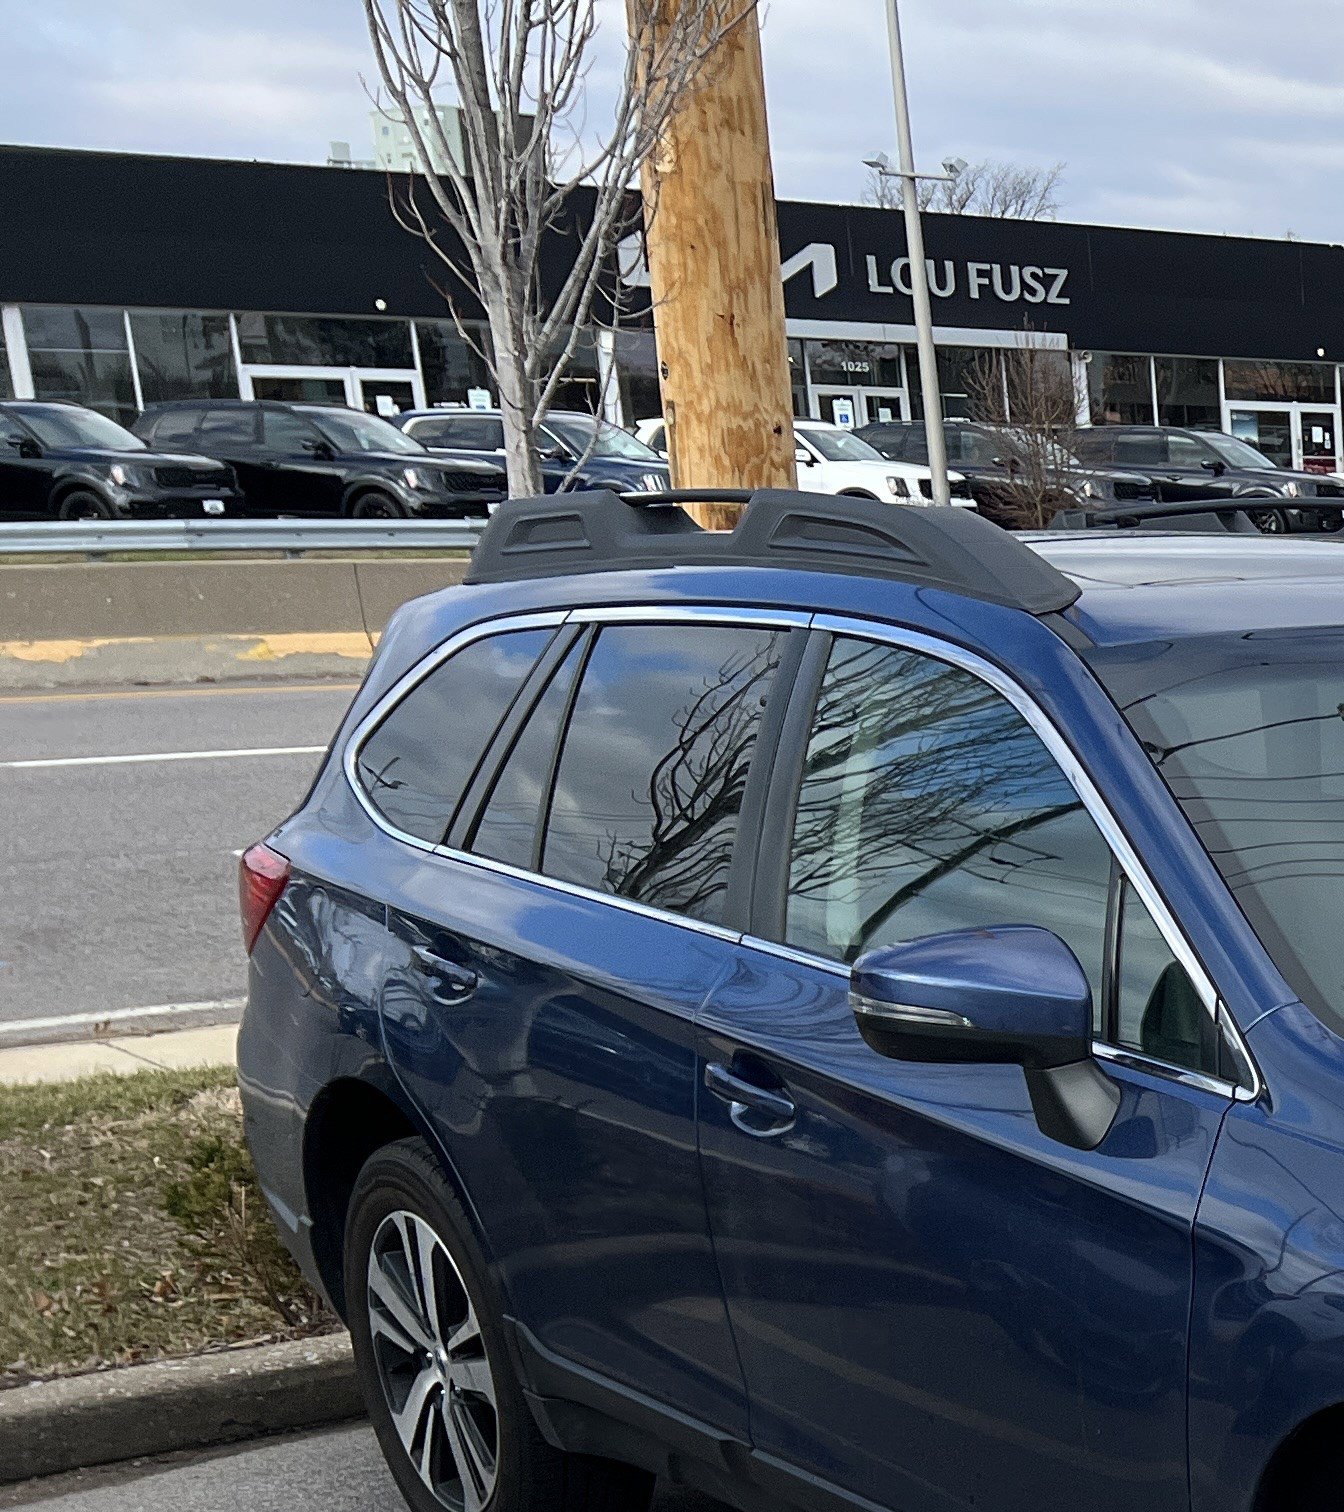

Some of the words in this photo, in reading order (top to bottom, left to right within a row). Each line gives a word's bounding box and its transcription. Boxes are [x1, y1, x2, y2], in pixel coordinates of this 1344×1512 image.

[866, 254, 957, 298] LOU
[967, 261, 1071, 305] FUSZ
[841, 360, 870, 373] 1025
